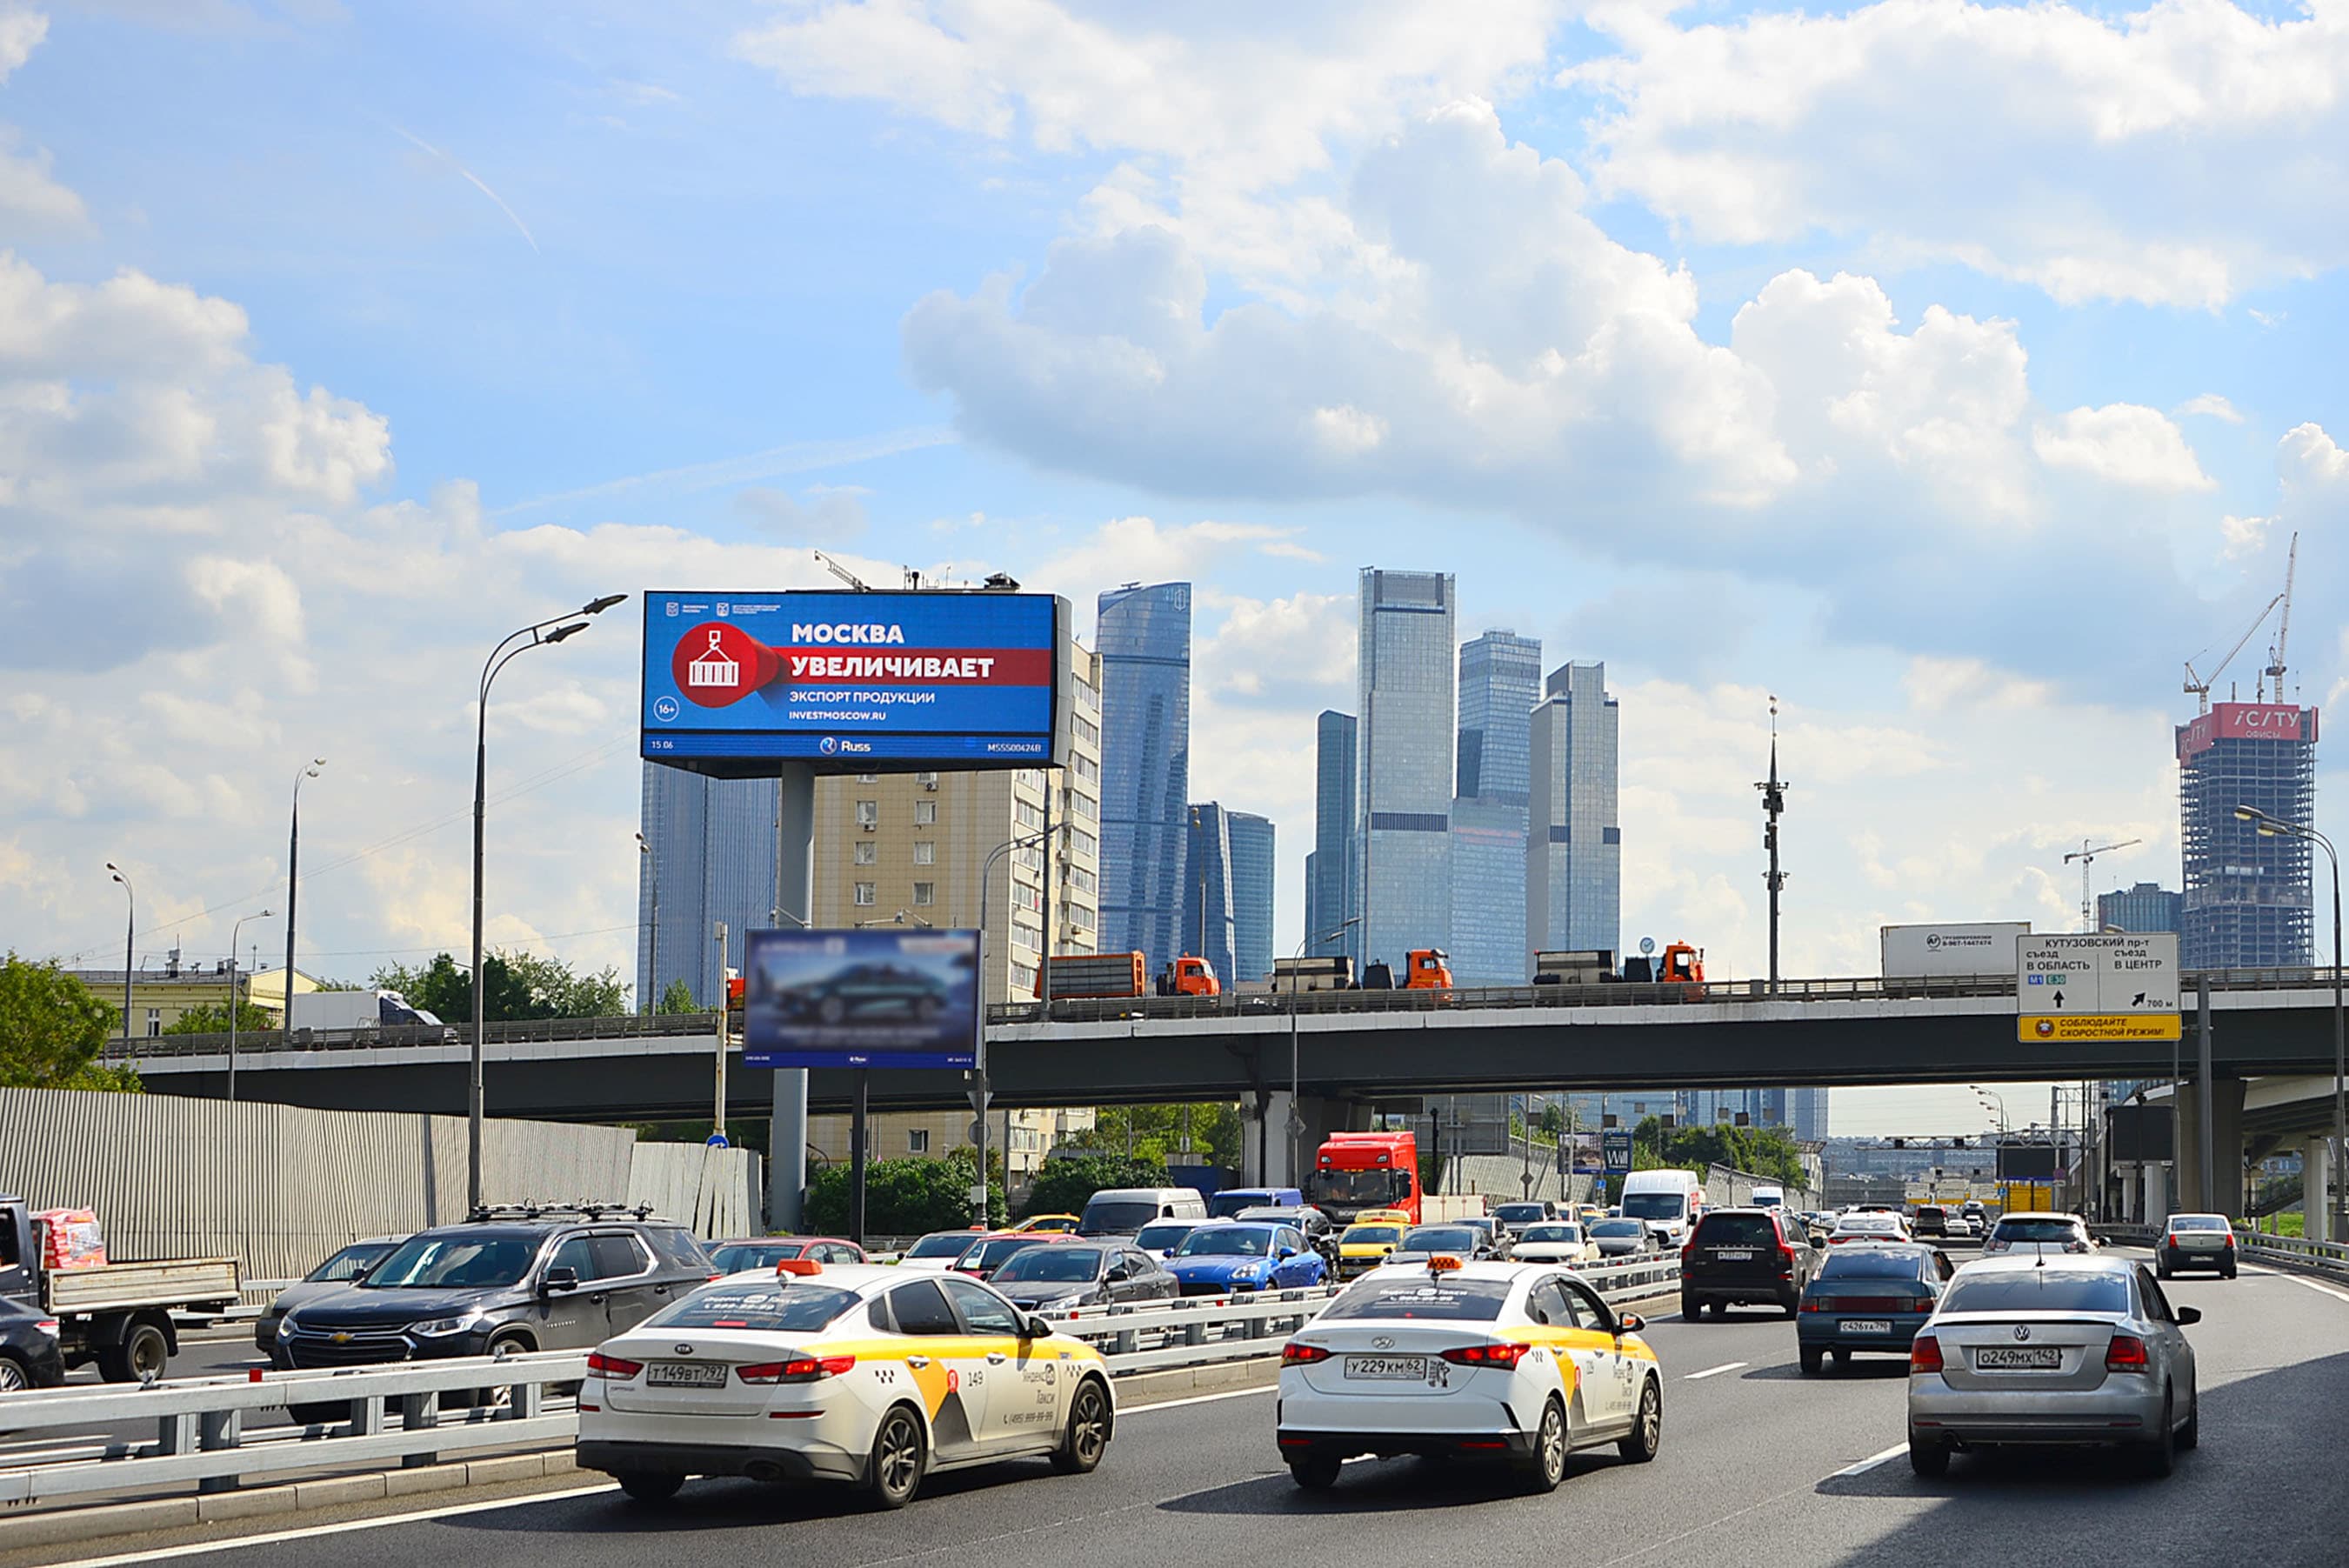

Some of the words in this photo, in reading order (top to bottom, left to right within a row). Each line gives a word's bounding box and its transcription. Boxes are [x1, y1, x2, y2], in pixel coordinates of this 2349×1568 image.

[791, 624, 904, 644] МОСКВА
[791, 657, 995, 677] УВЕЛИЧИВАЕТ
[789, 691, 851, 703] ЭКСПОРТ
[853, 692, 936, 705] ПРОДУКЦИИ
[658, 704, 676, 714] 16+
[789, 711, 887, 720] INVESTMOSCOW.RU
[841, 741, 871, 752] Russ
[2045, 937, 2125, 948] КУТУЗОВСКИЙ
[2127, 939, 2149, 948] пр-т
[2027, 962, 2034, 971] В
[2038, 961, 2090, 971] ОБЛАСТЬ
[2114, 960, 2122, 970] В
[2125, 959, 2162, 971] ЦЕНТР
[2048, 976, 2065, 984] E30
[2059, 1018, 2127, 1027] СОБЛЮДАЙТЕ
[2059, 1028, 2125, 1037] СКОРОСТНОЙ
[1607, 1151, 1628, 1164] Will
[1981, 1351, 2032, 1364] О249МХ
[2036, 1350, 2054, 1359] 142
[1351, 1359, 1404, 1373] У229КМ
[1406, 1359, 1420, 1370] 62
[653, 1365, 701, 1380] Т149ВТ
[703, 1366, 723, 1378] 797
[968, 1371, 984, 1386] 149
[1037, 1389, 1055, 1405] Такси
